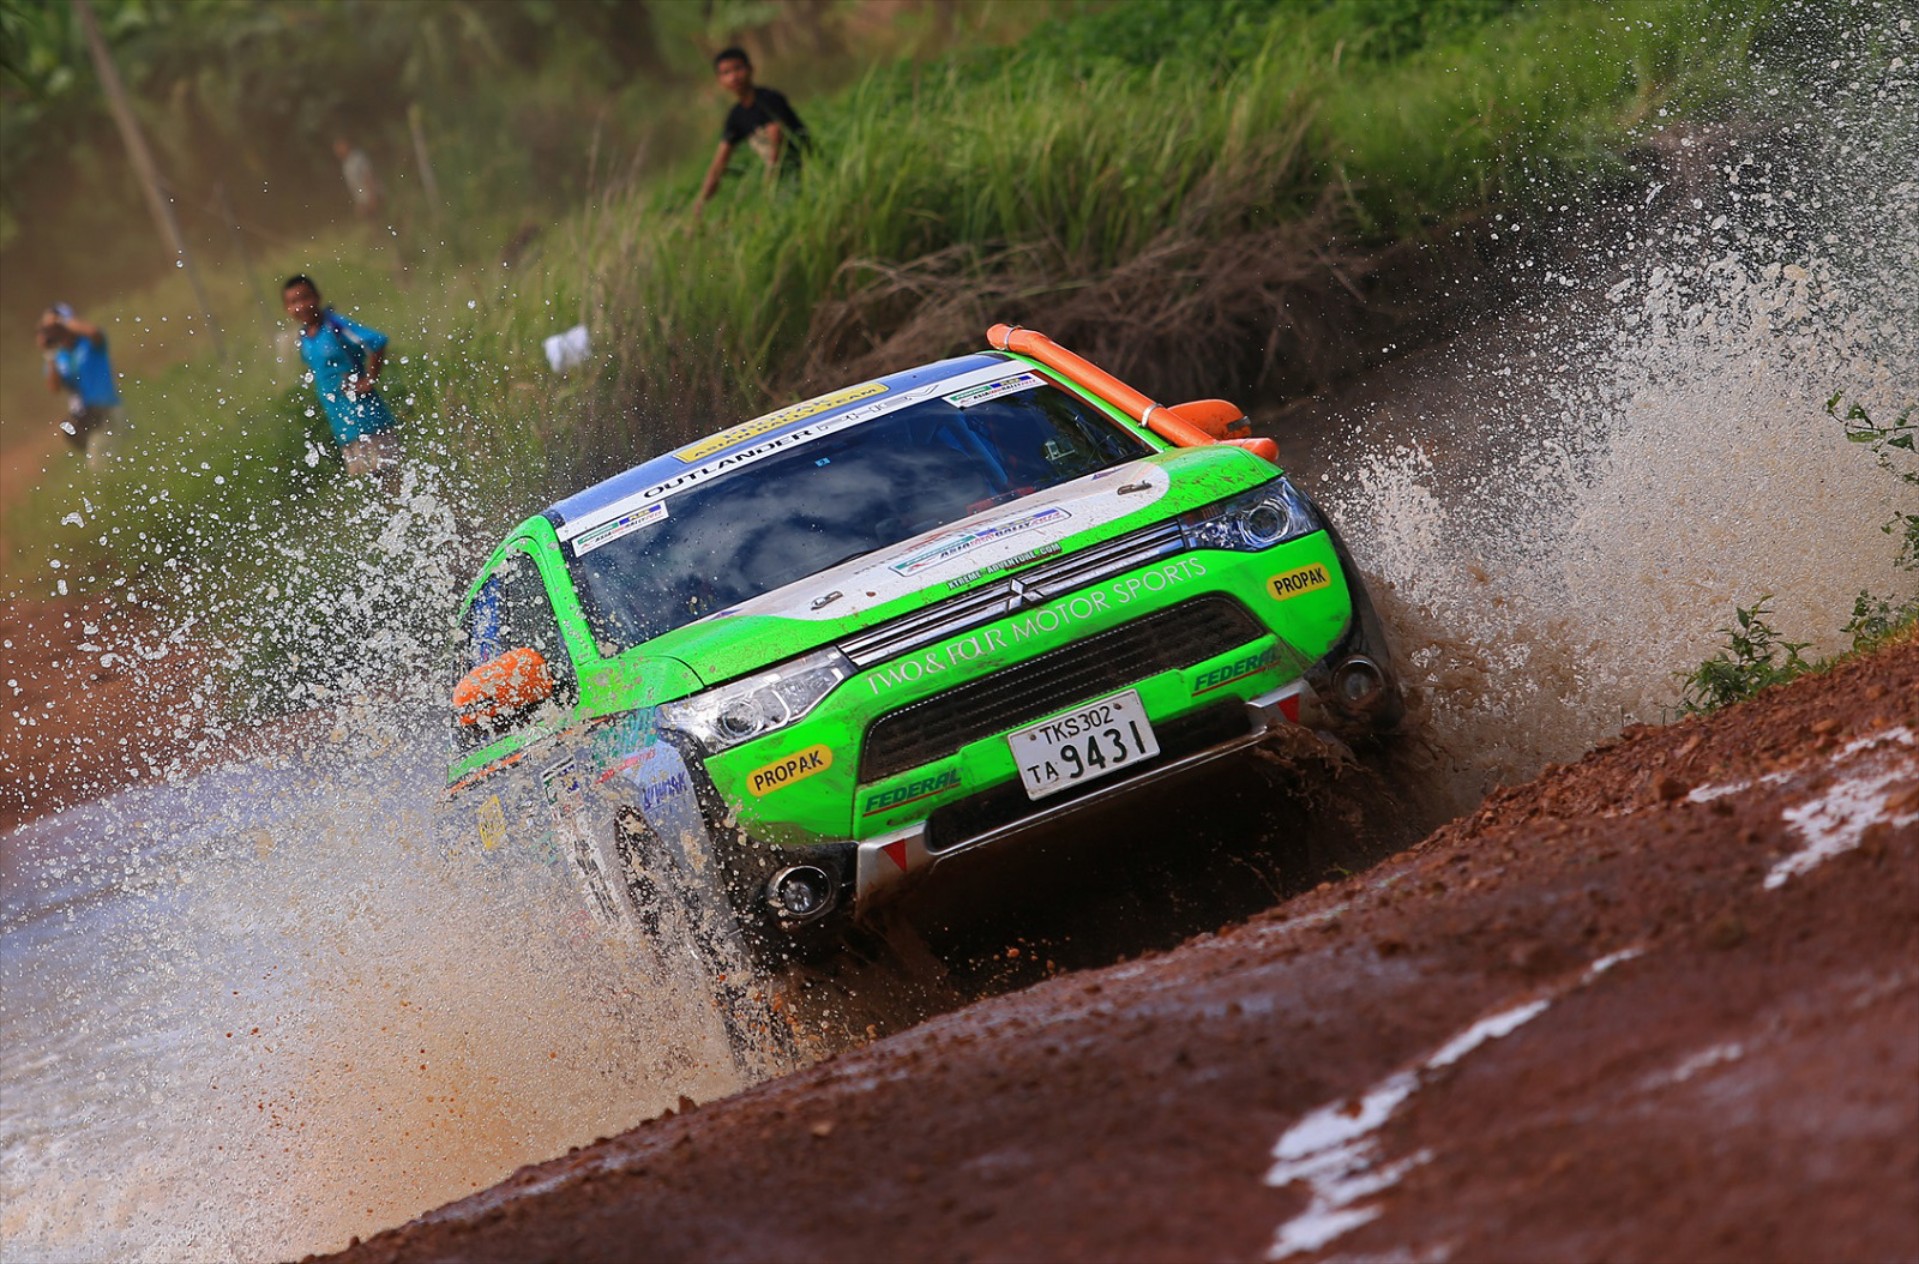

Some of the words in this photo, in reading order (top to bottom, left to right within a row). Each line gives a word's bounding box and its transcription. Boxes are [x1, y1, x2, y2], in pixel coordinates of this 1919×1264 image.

[694, 432, 751, 457] ASIAN
[757, 408, 815, 433] RALLY
[824, 388, 876, 407] TEAM
[643, 429, 813, 489] OUTLANDER
[1273, 567, 1327, 596] PROPAK
[867, 661, 922, 695] TWO
[946, 628, 1008, 665] FOUR
[1011, 590, 1111, 643] MOTOR
[1113, 556, 1207, 604] SPORTS
[1039, 705, 1114, 745] TKS302
[754, 750, 824, 792] PROPAK
[1026, 760, 1059, 784] TA
[1059, 720, 1147, 779] 9431
[865, 768, 962, 812] FEDERAL
